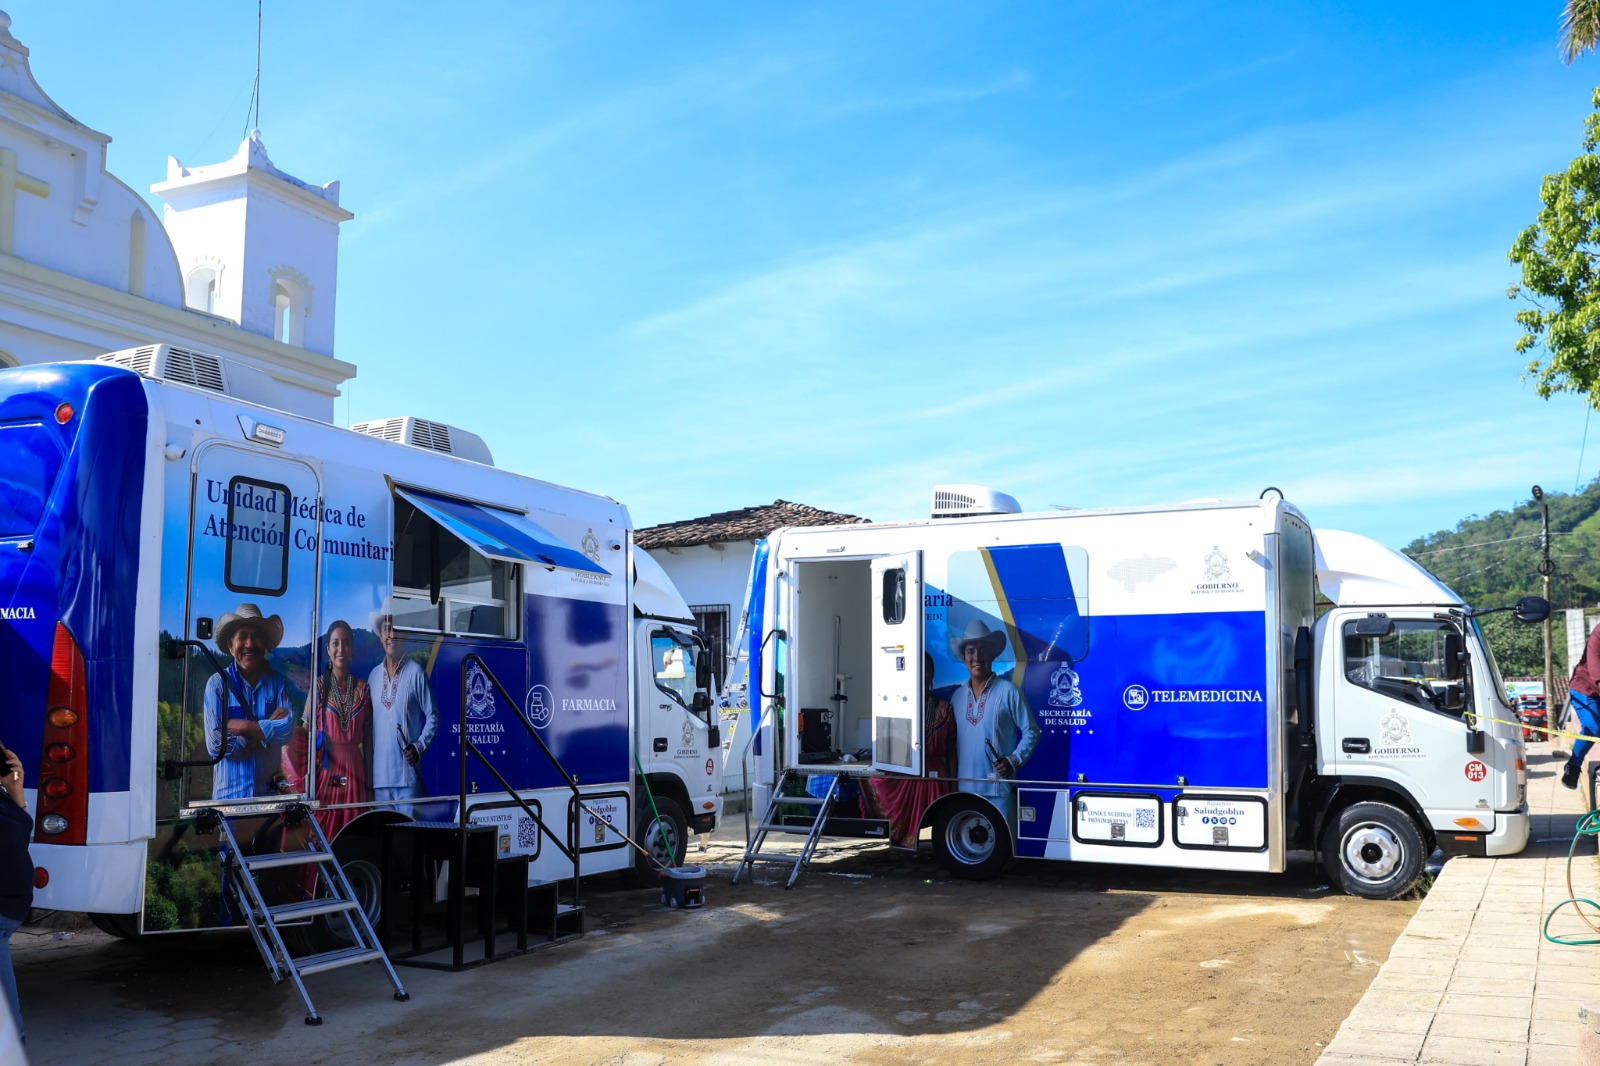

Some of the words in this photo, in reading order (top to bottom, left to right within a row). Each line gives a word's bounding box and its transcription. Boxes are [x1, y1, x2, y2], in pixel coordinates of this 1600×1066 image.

[207, 479, 276, 513] Unidad
[282, 494, 342, 525] Médica
[346, 505, 365, 528] de
[203, 513, 288, 546] Atención
[1196, 582, 1239, 590] GOBIERNO
[1151, 690, 1263, 703] TELEMEDICINA
[561, 699, 617, 711] FARMACIA
[1039, 709, 1092, 717] SECRETARÍA
[1058, 718, 1087, 726] SALUD
[471, 735, 500, 744] SALUD
[1468, 763, 1483, 772] CM
[1467, 771, 1484, 779] 013
[1194, 806, 1245, 816] Saludgobhn
